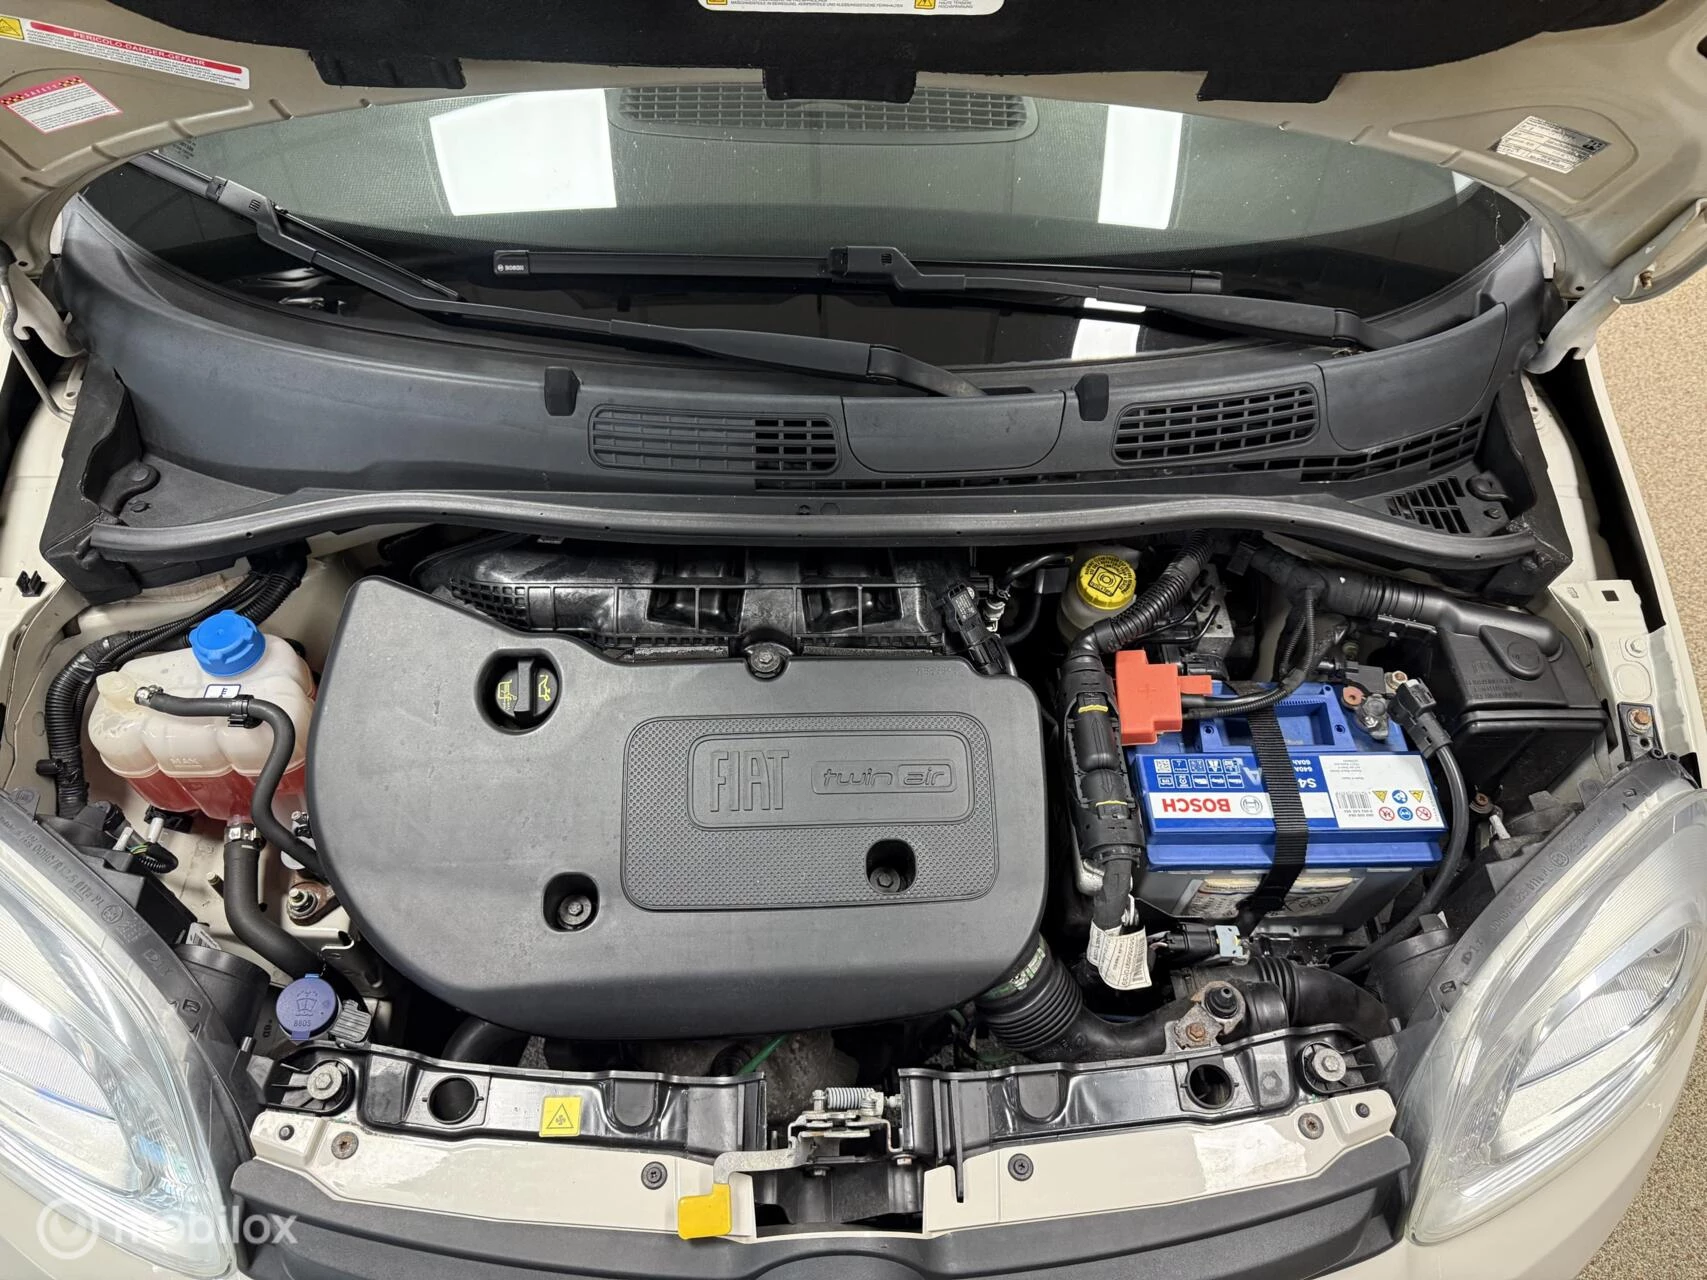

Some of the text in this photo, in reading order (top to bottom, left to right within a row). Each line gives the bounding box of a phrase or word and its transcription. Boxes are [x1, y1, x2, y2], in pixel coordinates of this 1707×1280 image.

[710, 750, 790, 813] FIAT
[1297, 777, 1317, 788] S4
[1162, 797, 1231, 812] BOSCH
